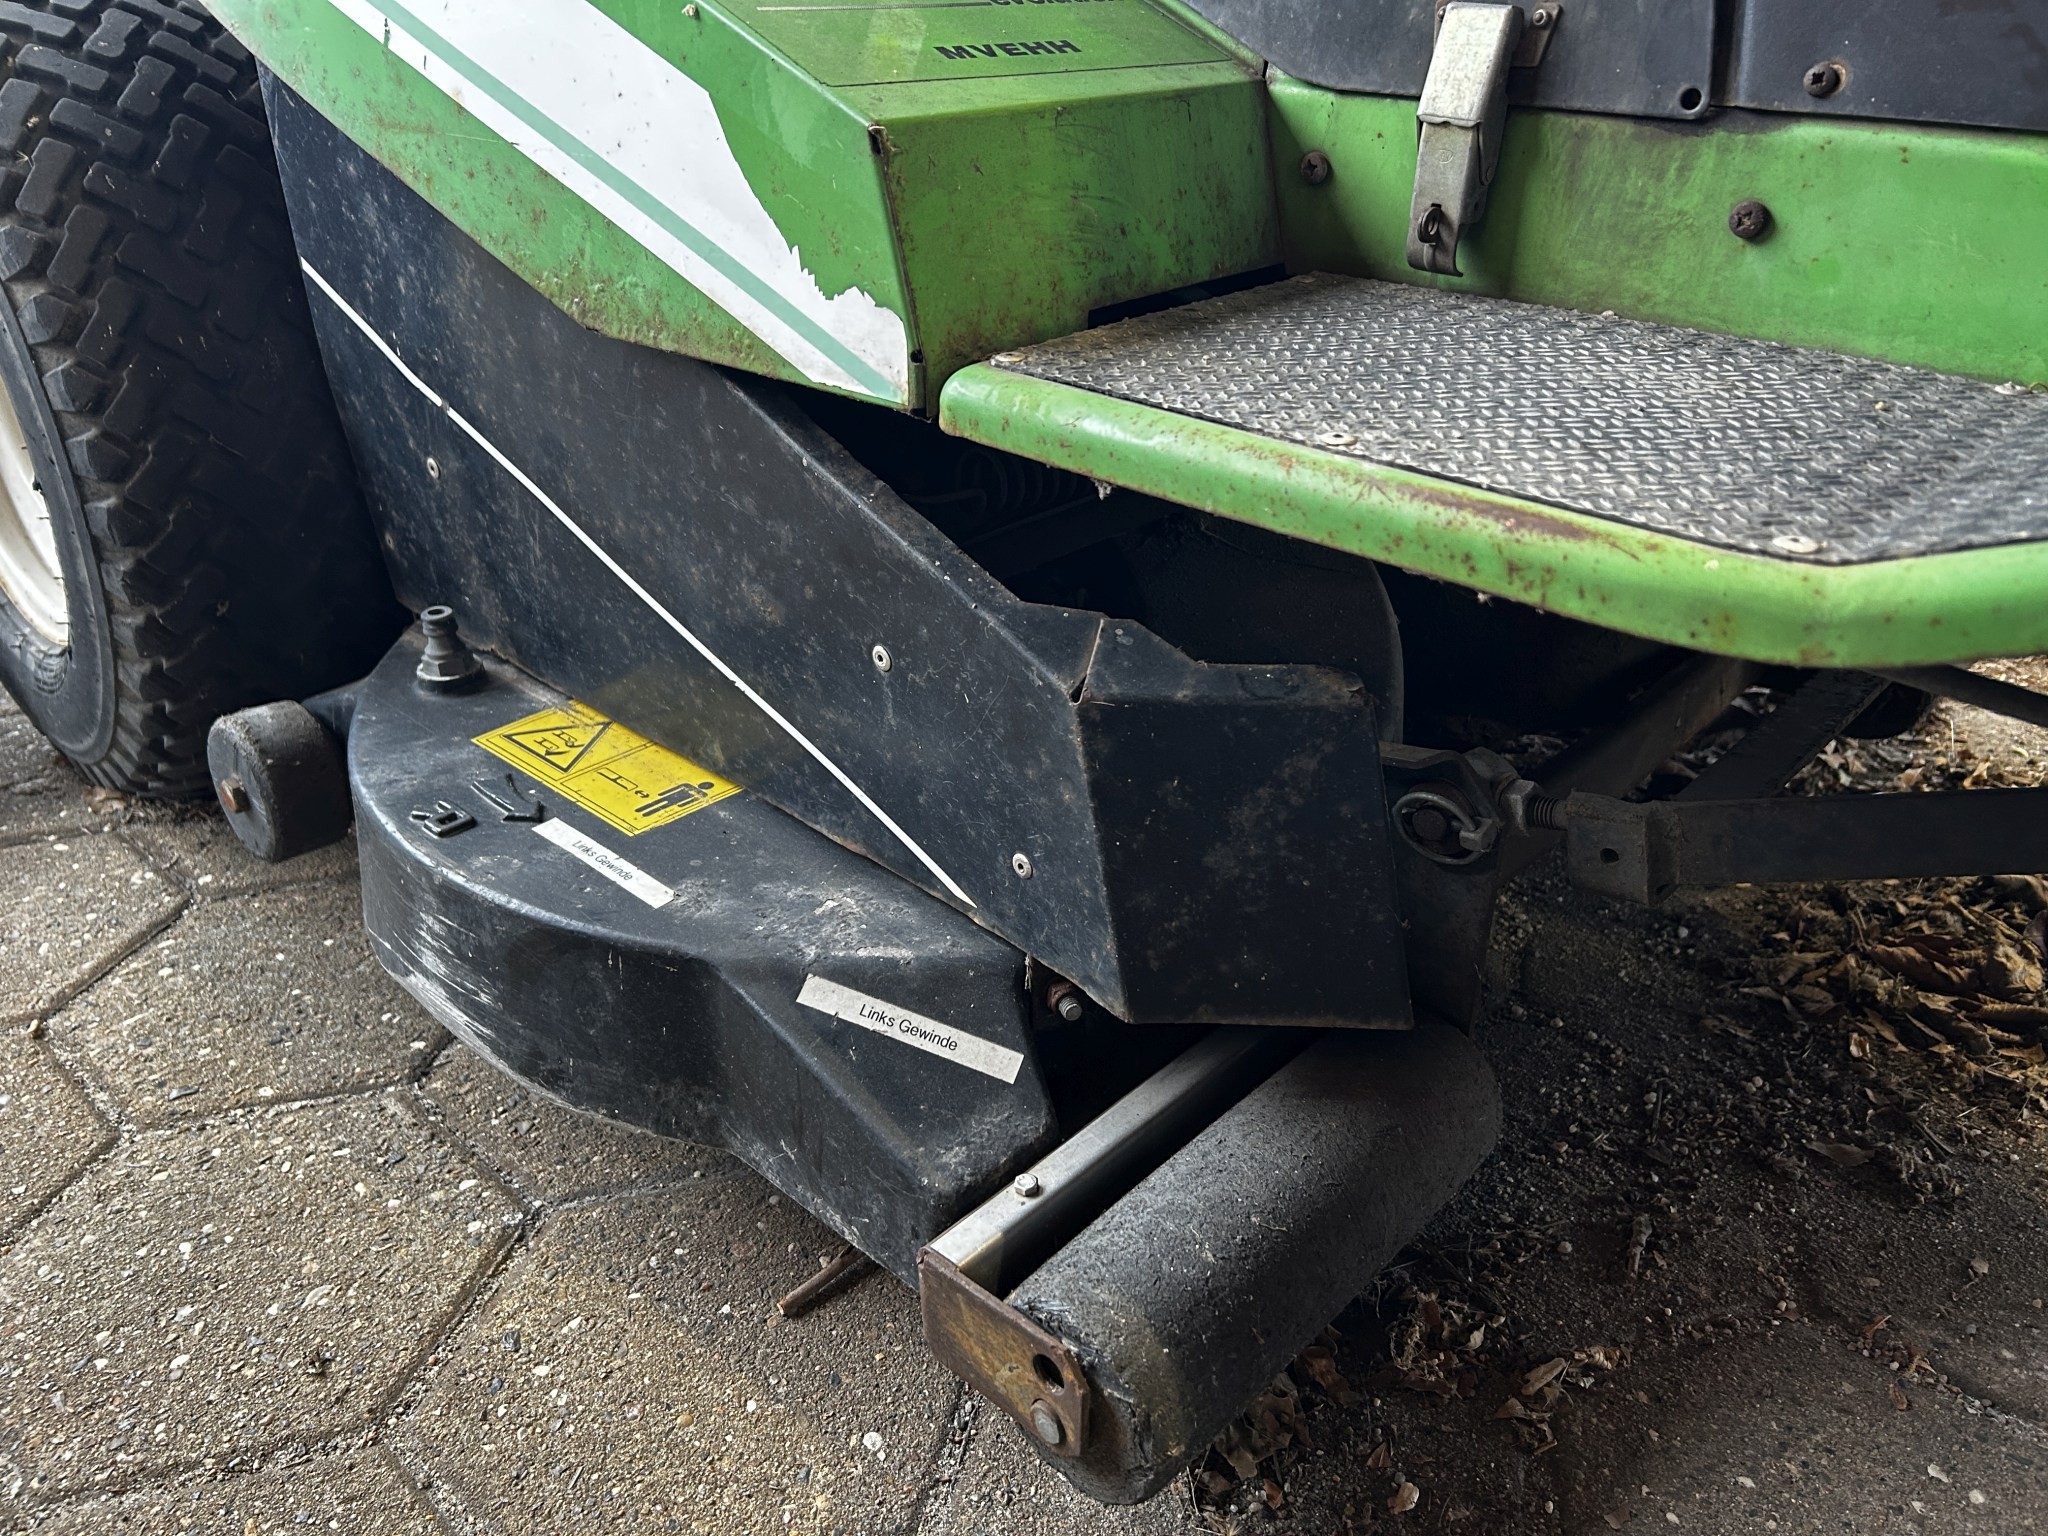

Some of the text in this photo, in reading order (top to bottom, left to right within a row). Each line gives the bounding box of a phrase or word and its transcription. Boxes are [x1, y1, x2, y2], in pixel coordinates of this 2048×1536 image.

[933, 39, 1082, 60] MVEHH
[571, 840, 633, 881] Links Gewinde
[859, 1003, 958, 1051] Links Gewinde
